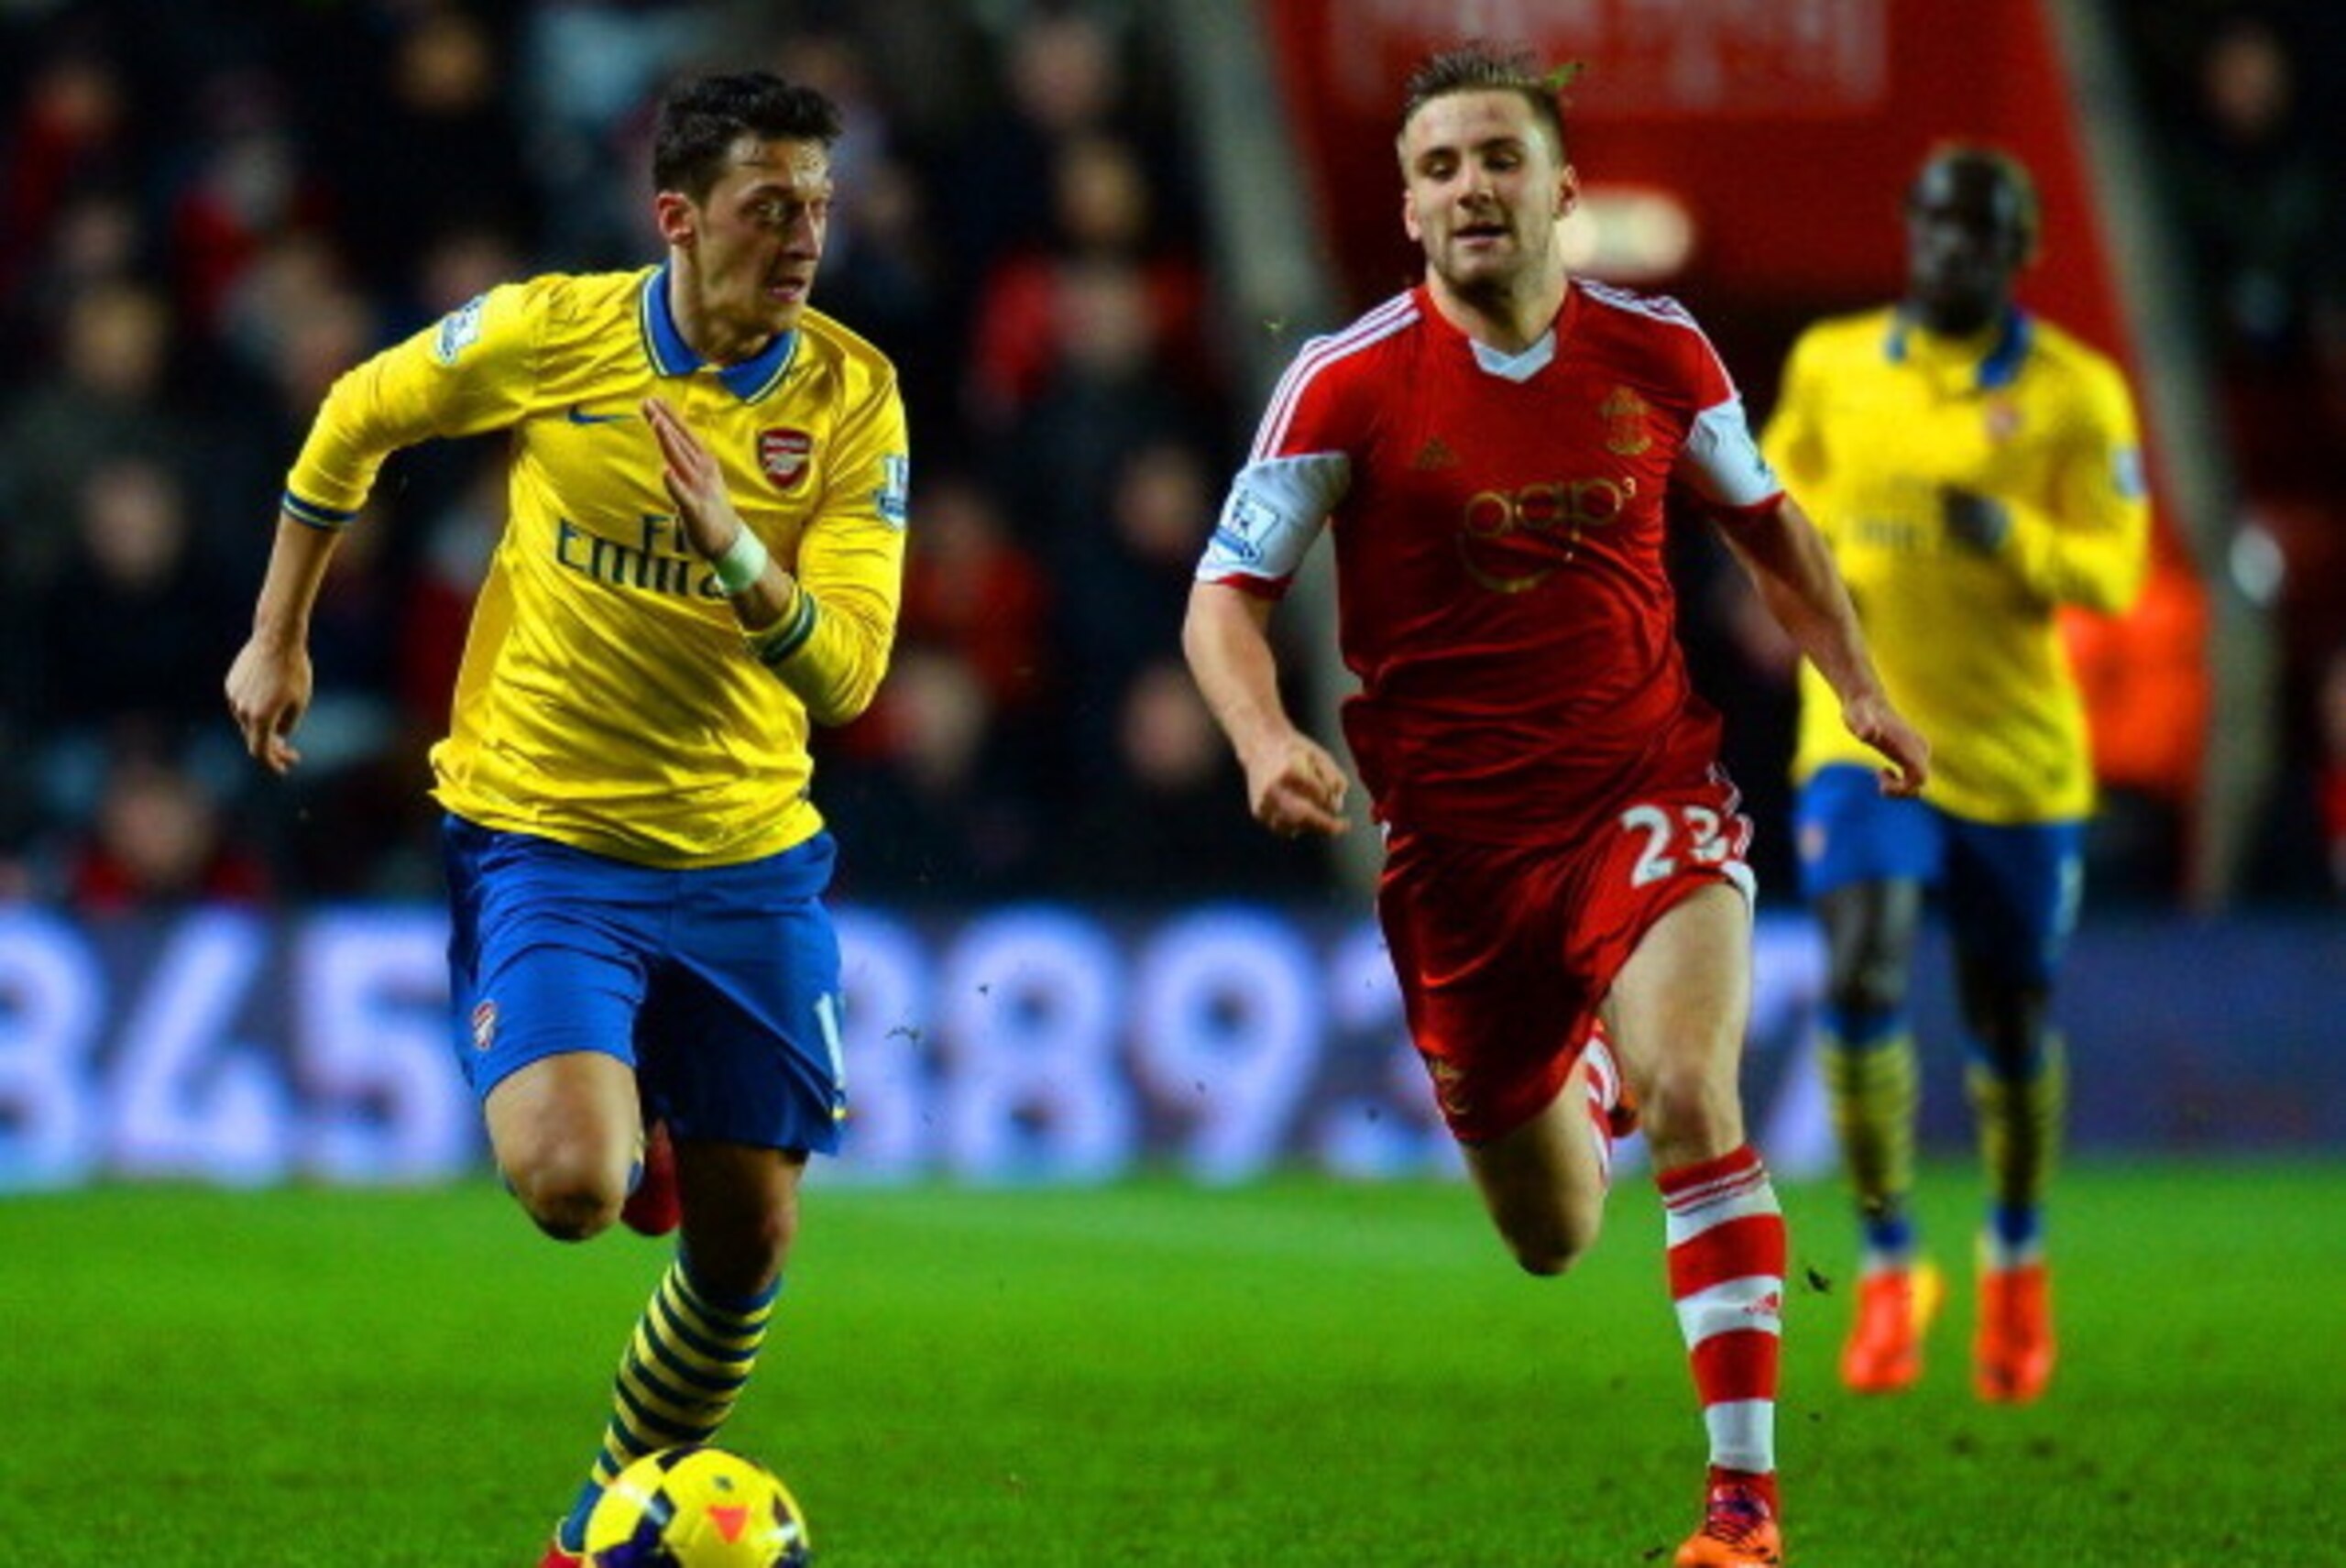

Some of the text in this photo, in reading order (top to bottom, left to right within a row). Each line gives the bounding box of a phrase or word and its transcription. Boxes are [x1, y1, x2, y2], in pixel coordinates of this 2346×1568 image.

[556, 516, 730, 600] Emira
[641, 513, 686, 554] Fl
[1618, 804, 1730, 887] 23
